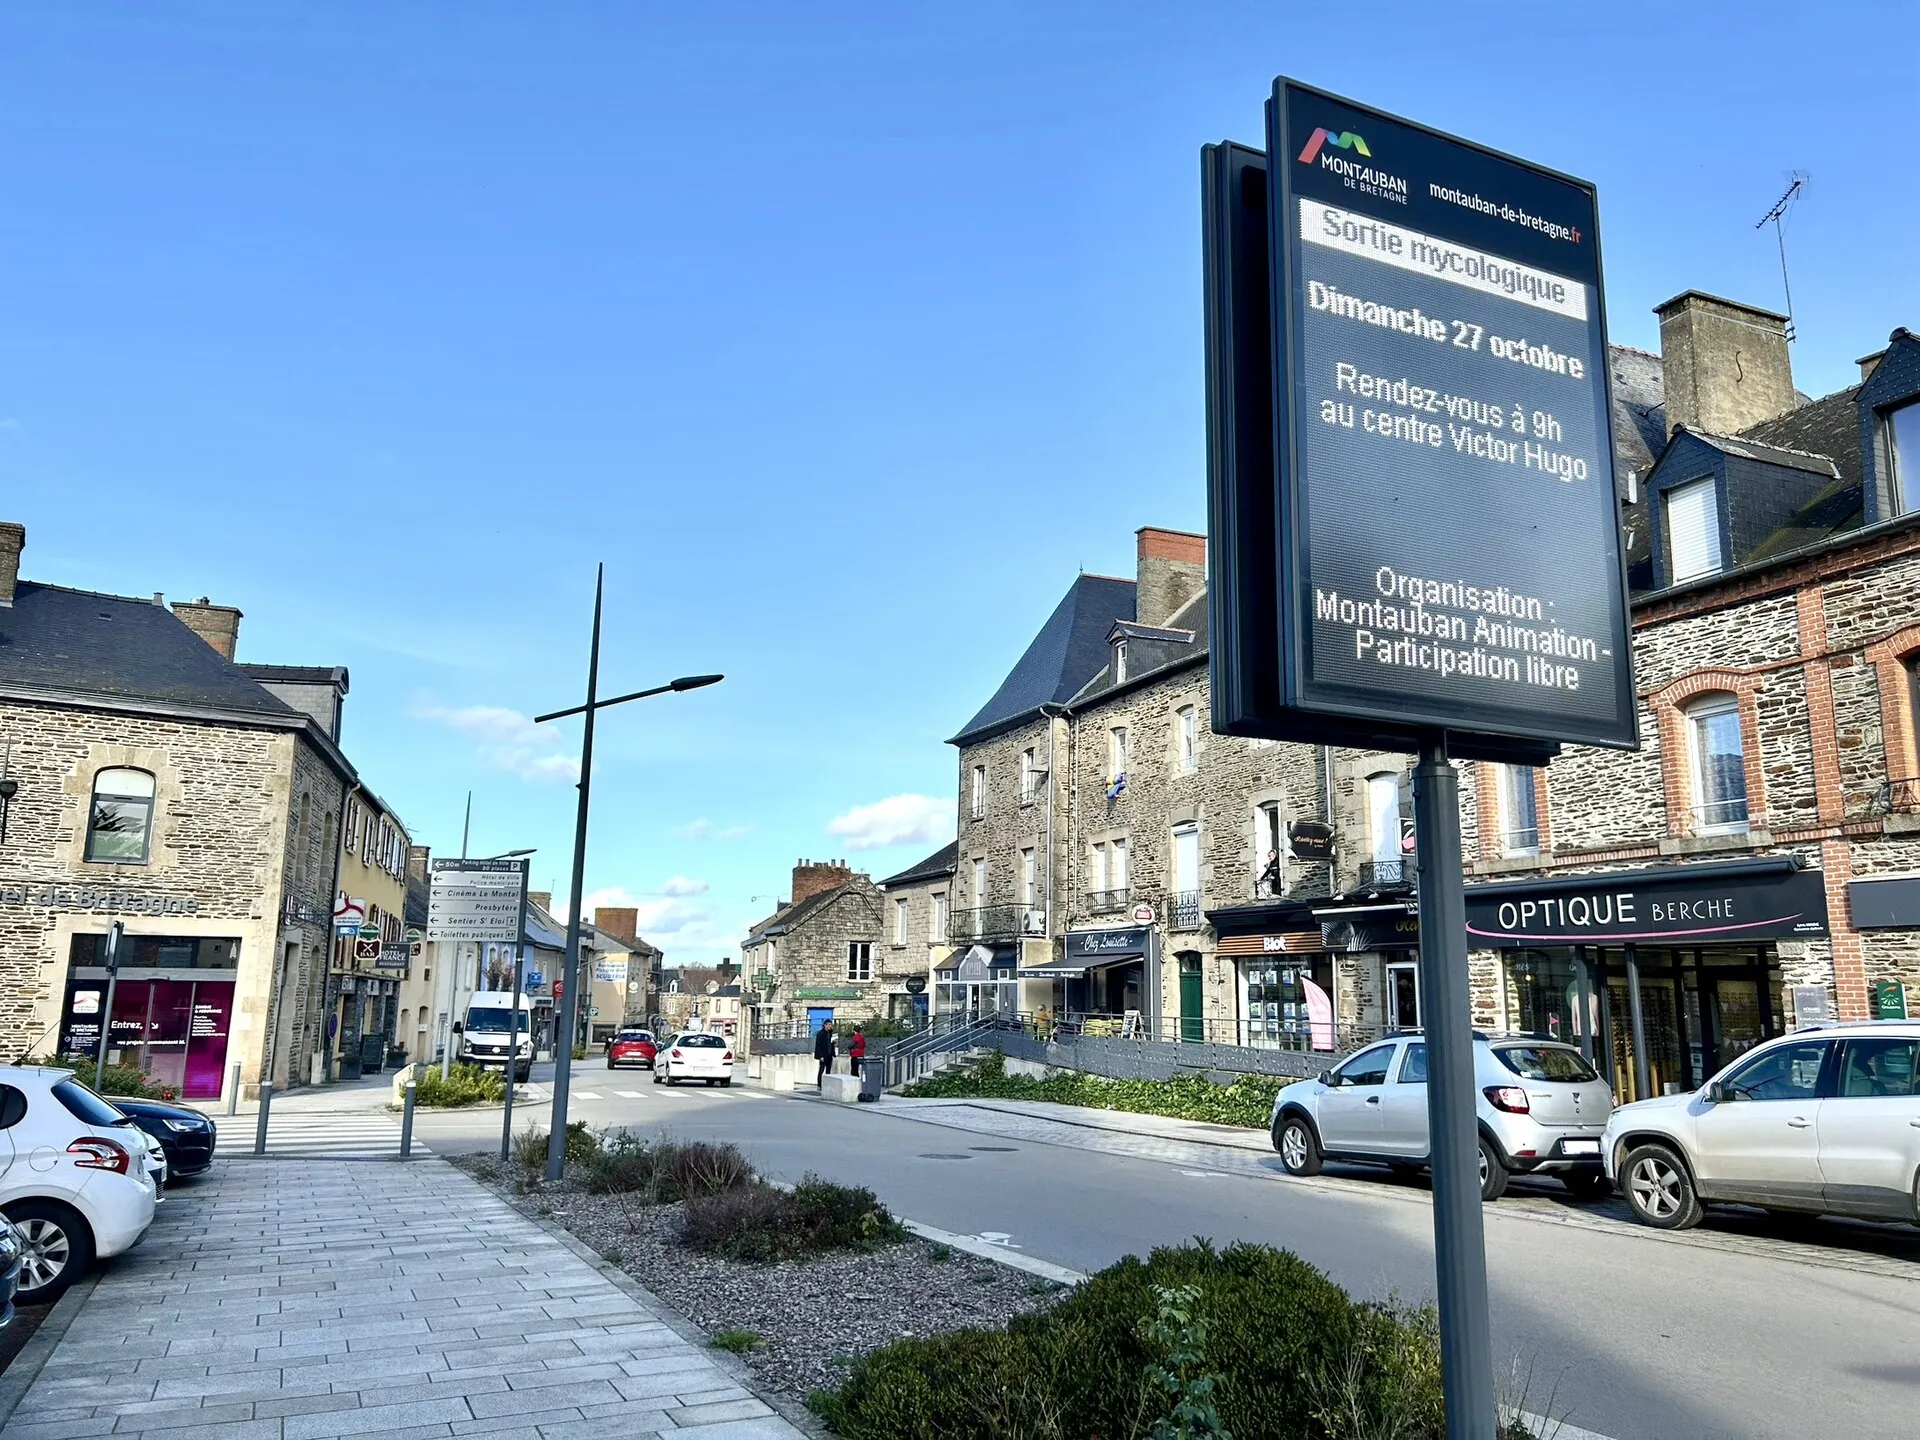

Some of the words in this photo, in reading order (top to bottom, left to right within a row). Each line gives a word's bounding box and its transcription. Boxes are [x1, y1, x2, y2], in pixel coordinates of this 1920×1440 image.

[1321, 151, 1407, 194] MONTAUBAN
[1344, 177, 1357, 190] DE
[1360, 181, 1407, 205] BRETAGNE
[1429, 181, 1582, 244] montauban-de-bretagne.fr
[1322, 209, 1403, 255] Sortie
[1410, 238, 1566, 304] mycologique
[1308, 280, 1447, 342] Dimanche
[1450, 319, 1483, 350] 27
[1490, 334, 1584, 379] octobre
[1336, 361, 1503, 428] Rendez-vous
[1511, 405, 1526, 433] à
[1532, 411, 1562, 442] 9h
[1320, 399, 1354, 428] au
[1362, 409, 1443, 447] centre
[1448, 422, 1519, 464] Victor
[1524, 440, 1587, 482] Hugo
[1376, 566, 1542, 620] Organisation
[1316, 589, 1467, 641] Montauban
[1473, 615, 1597, 662] Animation
[1356, 629, 1519, 682] Participation
[1526, 655, 1579, 690] libre
[35, 886, 69, 906] de
[77, 888, 200, 916] Bretagne
[448, 889, 476, 897] Cinéma
[475, 903, 518, 911] Presbytère
[1498, 893, 1638, 930] OPTIQUE
[1652, 898, 1735, 922] BERCHE
[440, 930, 469, 938] Toilettes
[471, 931, 504, 939] publiques
[1084, 934, 1099, 952] Chez
[1100, 934, 1129, 948] Louisette
[1263, 936, 1287, 951] Blot
[111, 1020, 144, 1030] Entrez,
